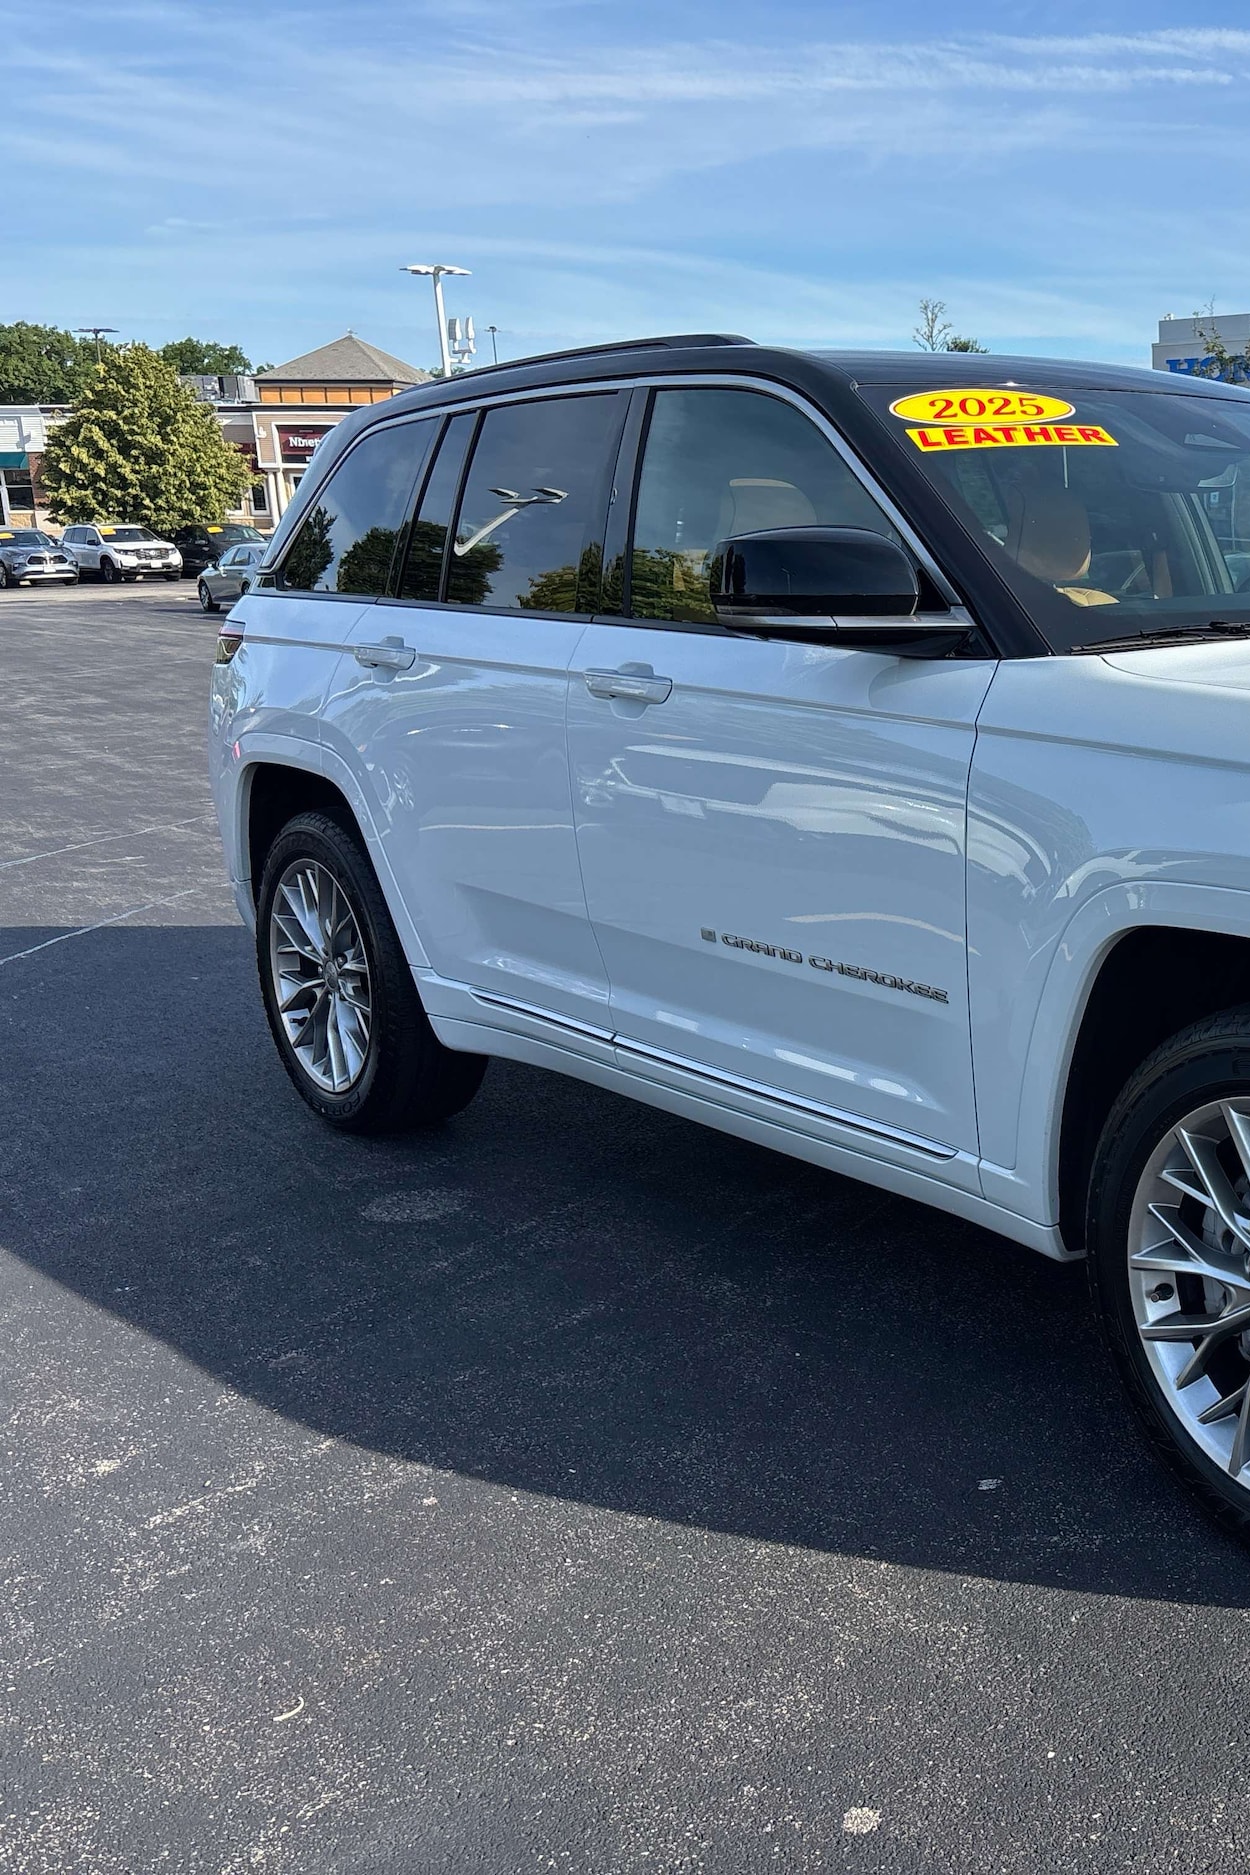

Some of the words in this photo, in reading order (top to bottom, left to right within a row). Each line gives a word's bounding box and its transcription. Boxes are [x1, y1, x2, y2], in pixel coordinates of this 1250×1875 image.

[928, 396, 1045, 419] 2025
[289, 436, 321, 447] Ninet
[917, 427, 1113, 448] LEATHER
[721, 933, 803, 964] GRAND
[808, 955, 949, 1004] CHEROKEE
